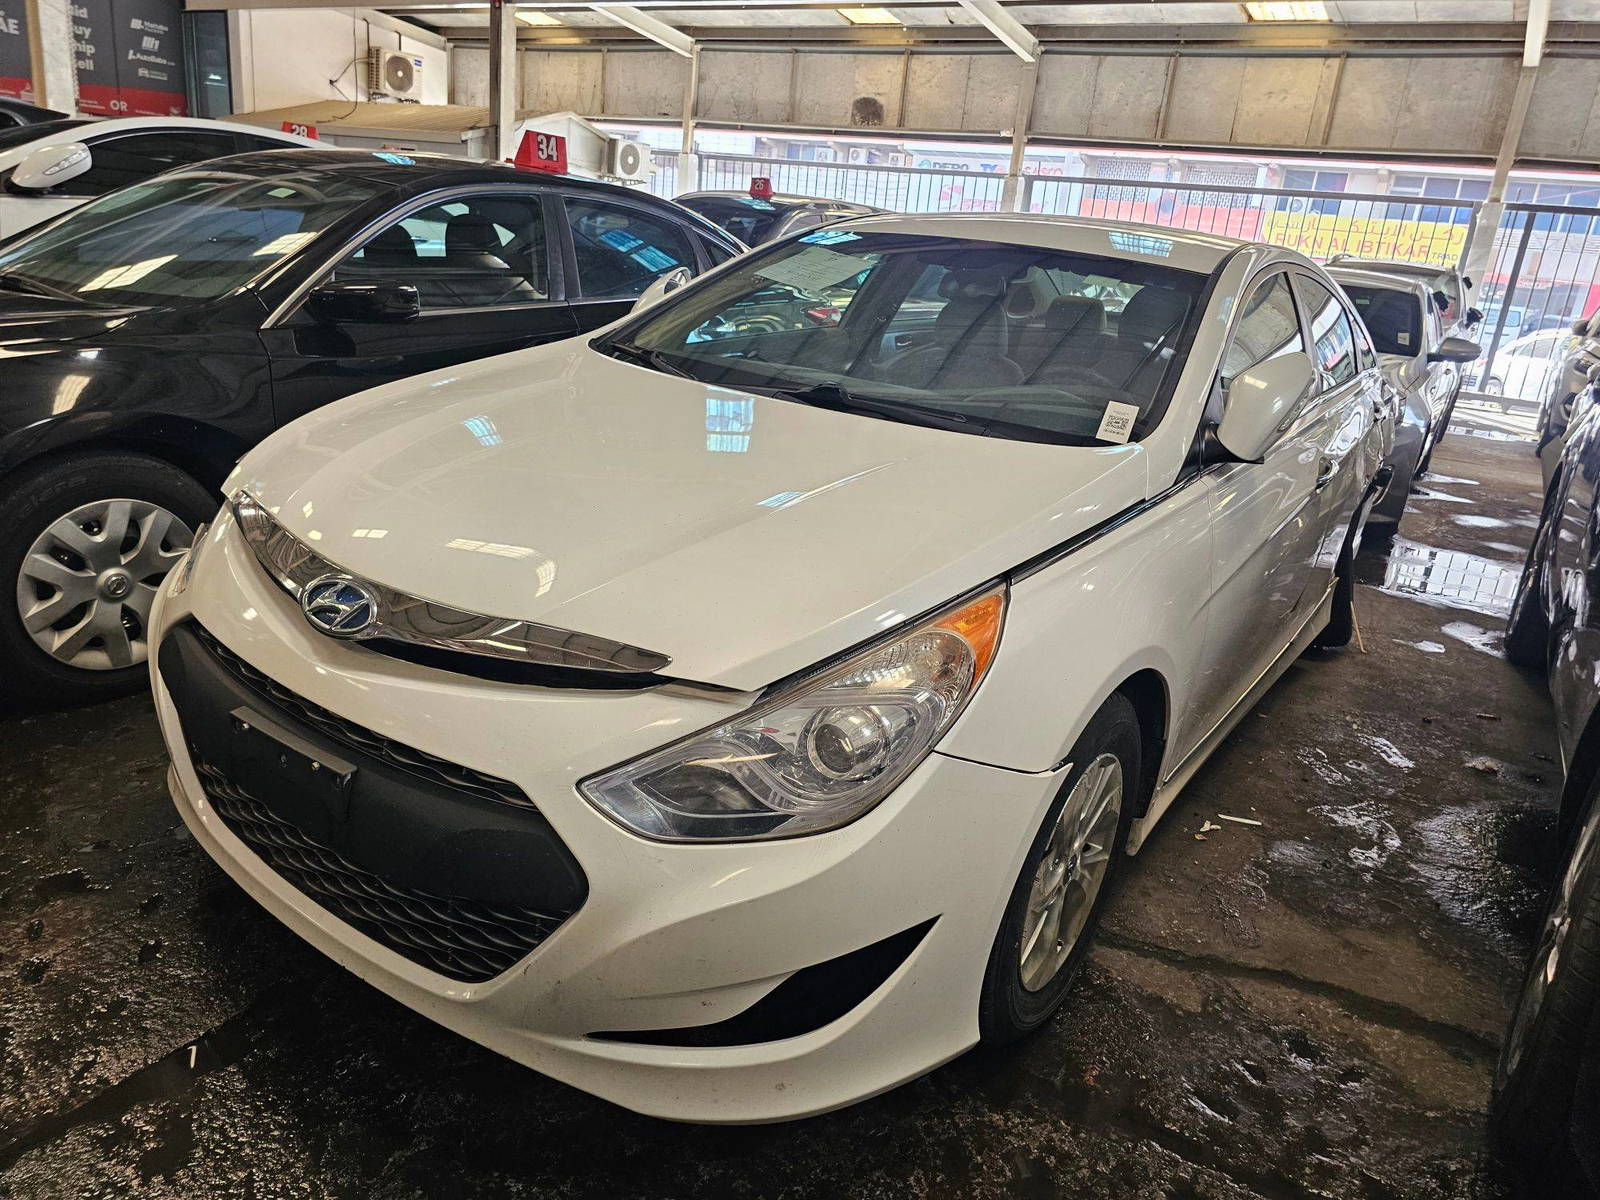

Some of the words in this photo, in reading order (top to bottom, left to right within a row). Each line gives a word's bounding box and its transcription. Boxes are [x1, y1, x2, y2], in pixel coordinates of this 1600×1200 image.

[72, 5, 88, 19] id
[73, 25, 92, 39] uy
[77, 59, 94, 71] ell
[109, 99, 128, 112] OR
[537, 134, 558, 161] 34
[1275, 231, 1324, 249] RUKN
[1331, 236, 1350, 252] AL
[1354, 239, 1430, 258] IBTIKAR
